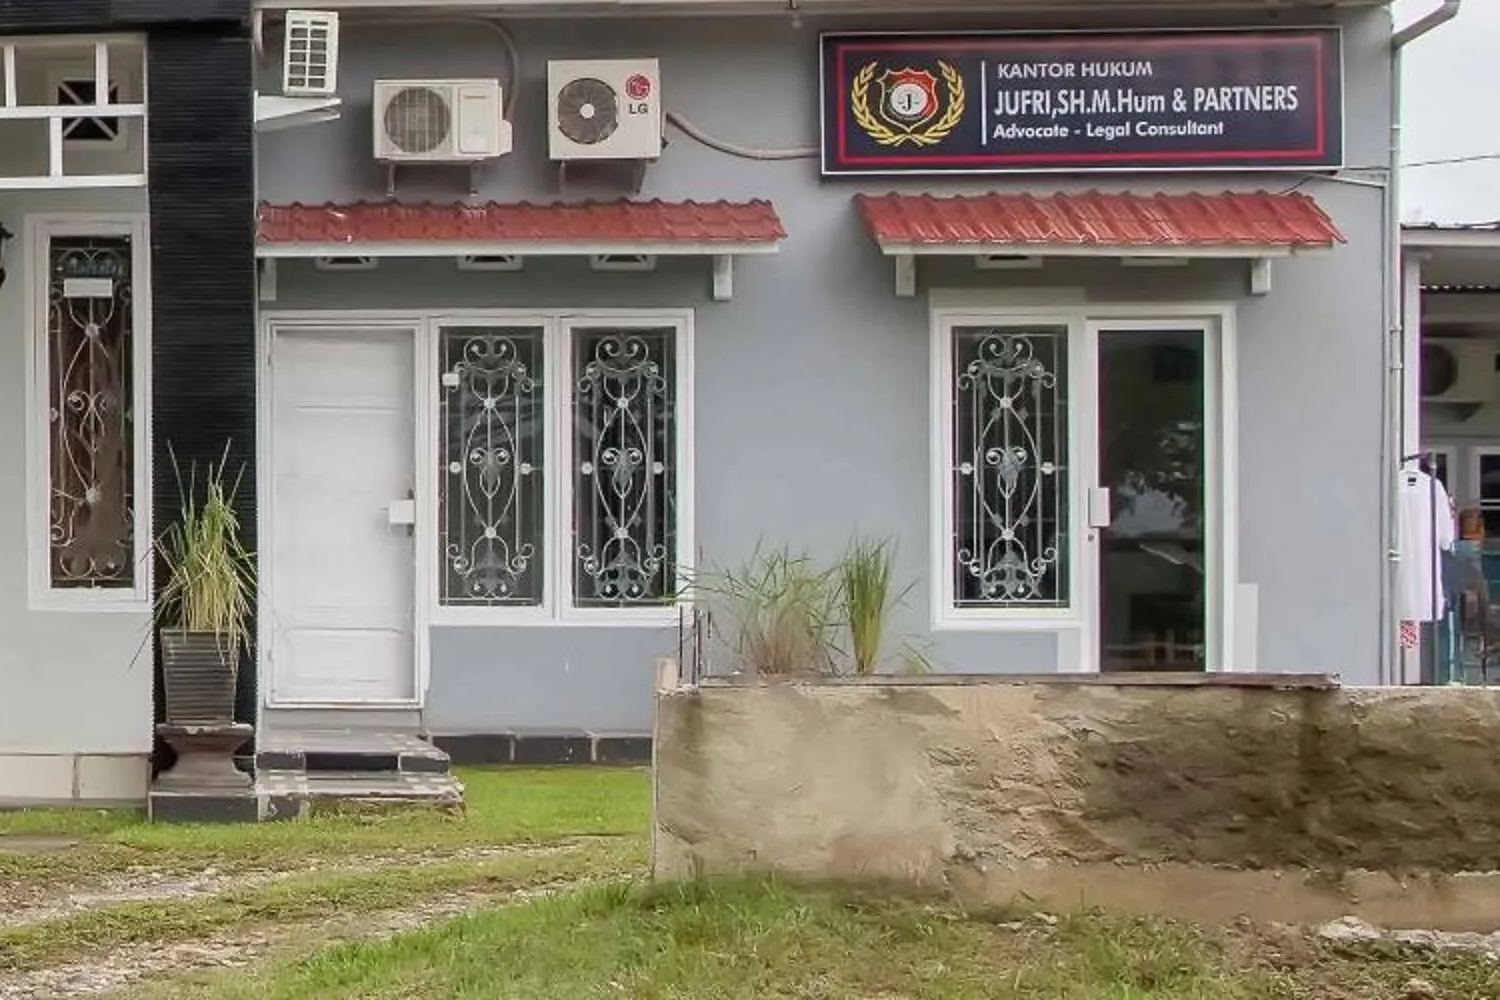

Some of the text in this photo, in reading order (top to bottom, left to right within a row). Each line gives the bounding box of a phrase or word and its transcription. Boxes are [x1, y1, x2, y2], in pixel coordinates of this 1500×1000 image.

[998, 61, 1153, 79] KANTOR HUKUM
[1172, 87, 1187, 112] &
[1193, 85, 1298, 111] PARTNERS
[629, 103, 648, 114] LG
[993, 123, 1069, 138] Advocate
[1086, 121, 1130, 140] Legal
[1135, 119, 1224, 136] Consultant
